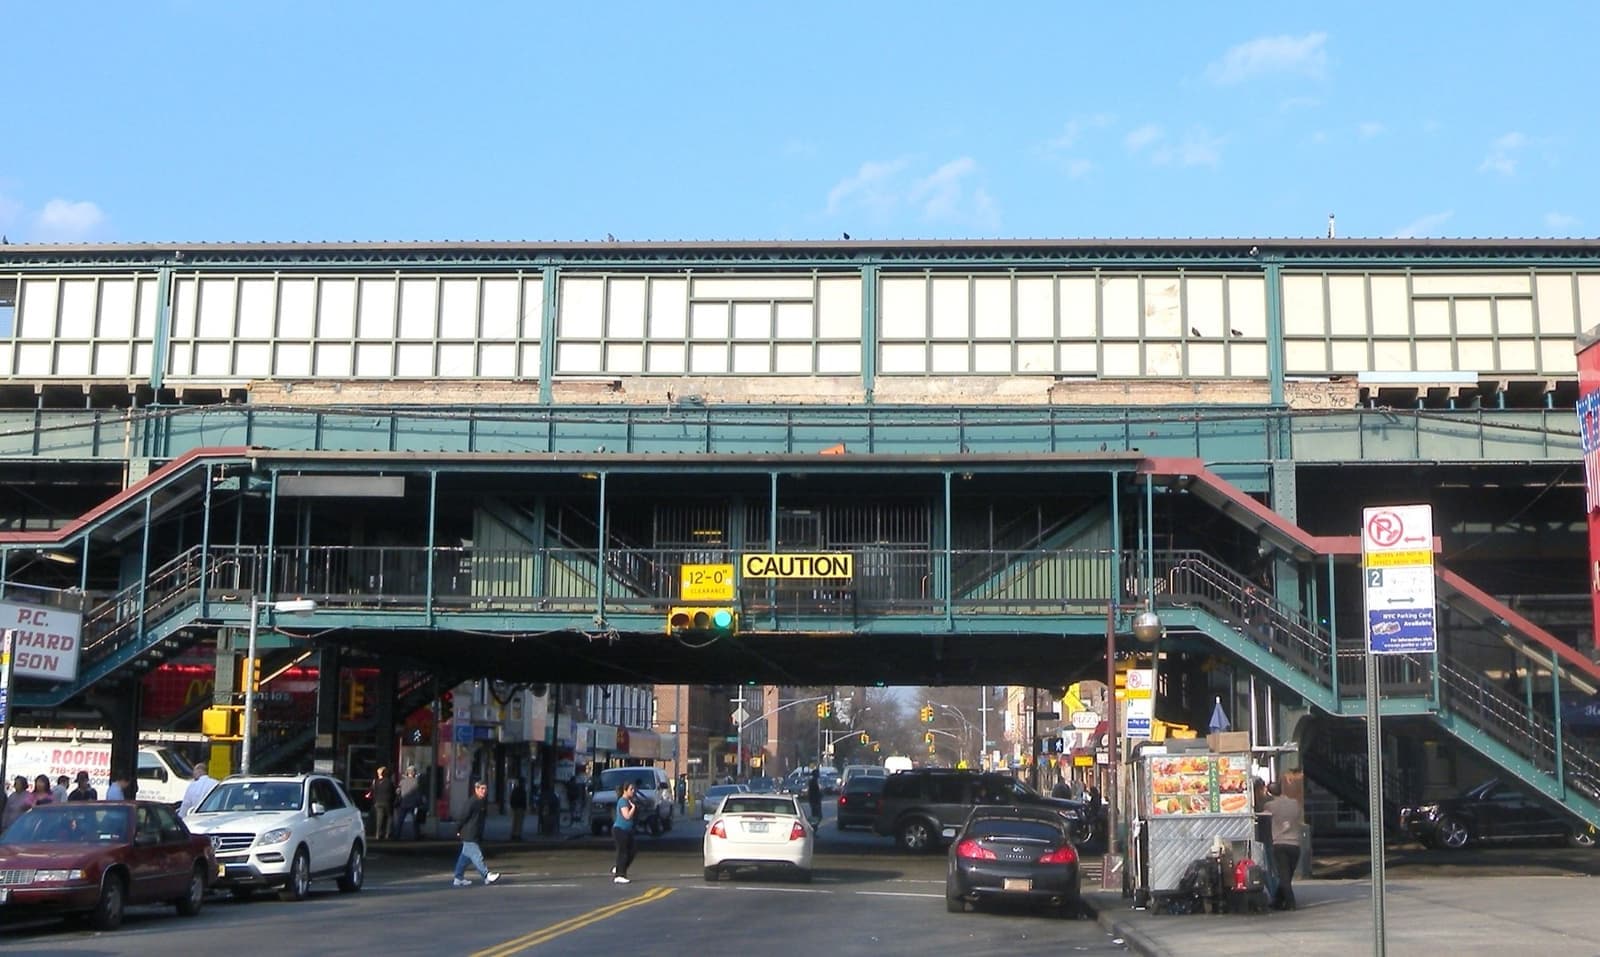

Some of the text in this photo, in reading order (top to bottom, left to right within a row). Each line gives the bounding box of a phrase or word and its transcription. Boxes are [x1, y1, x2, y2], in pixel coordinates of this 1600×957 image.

[746, 556, 848, 576] CAUTION
[1371, 571, 1381, 586] 2
[18, 608, 49, 627] P.C.
[18, 630, 75, 651] HARD
[15, 652, 59, 671] SON
[1073, 715, 1097, 724] PIZZA
[51, 749, 109, 766] ROOFIN
